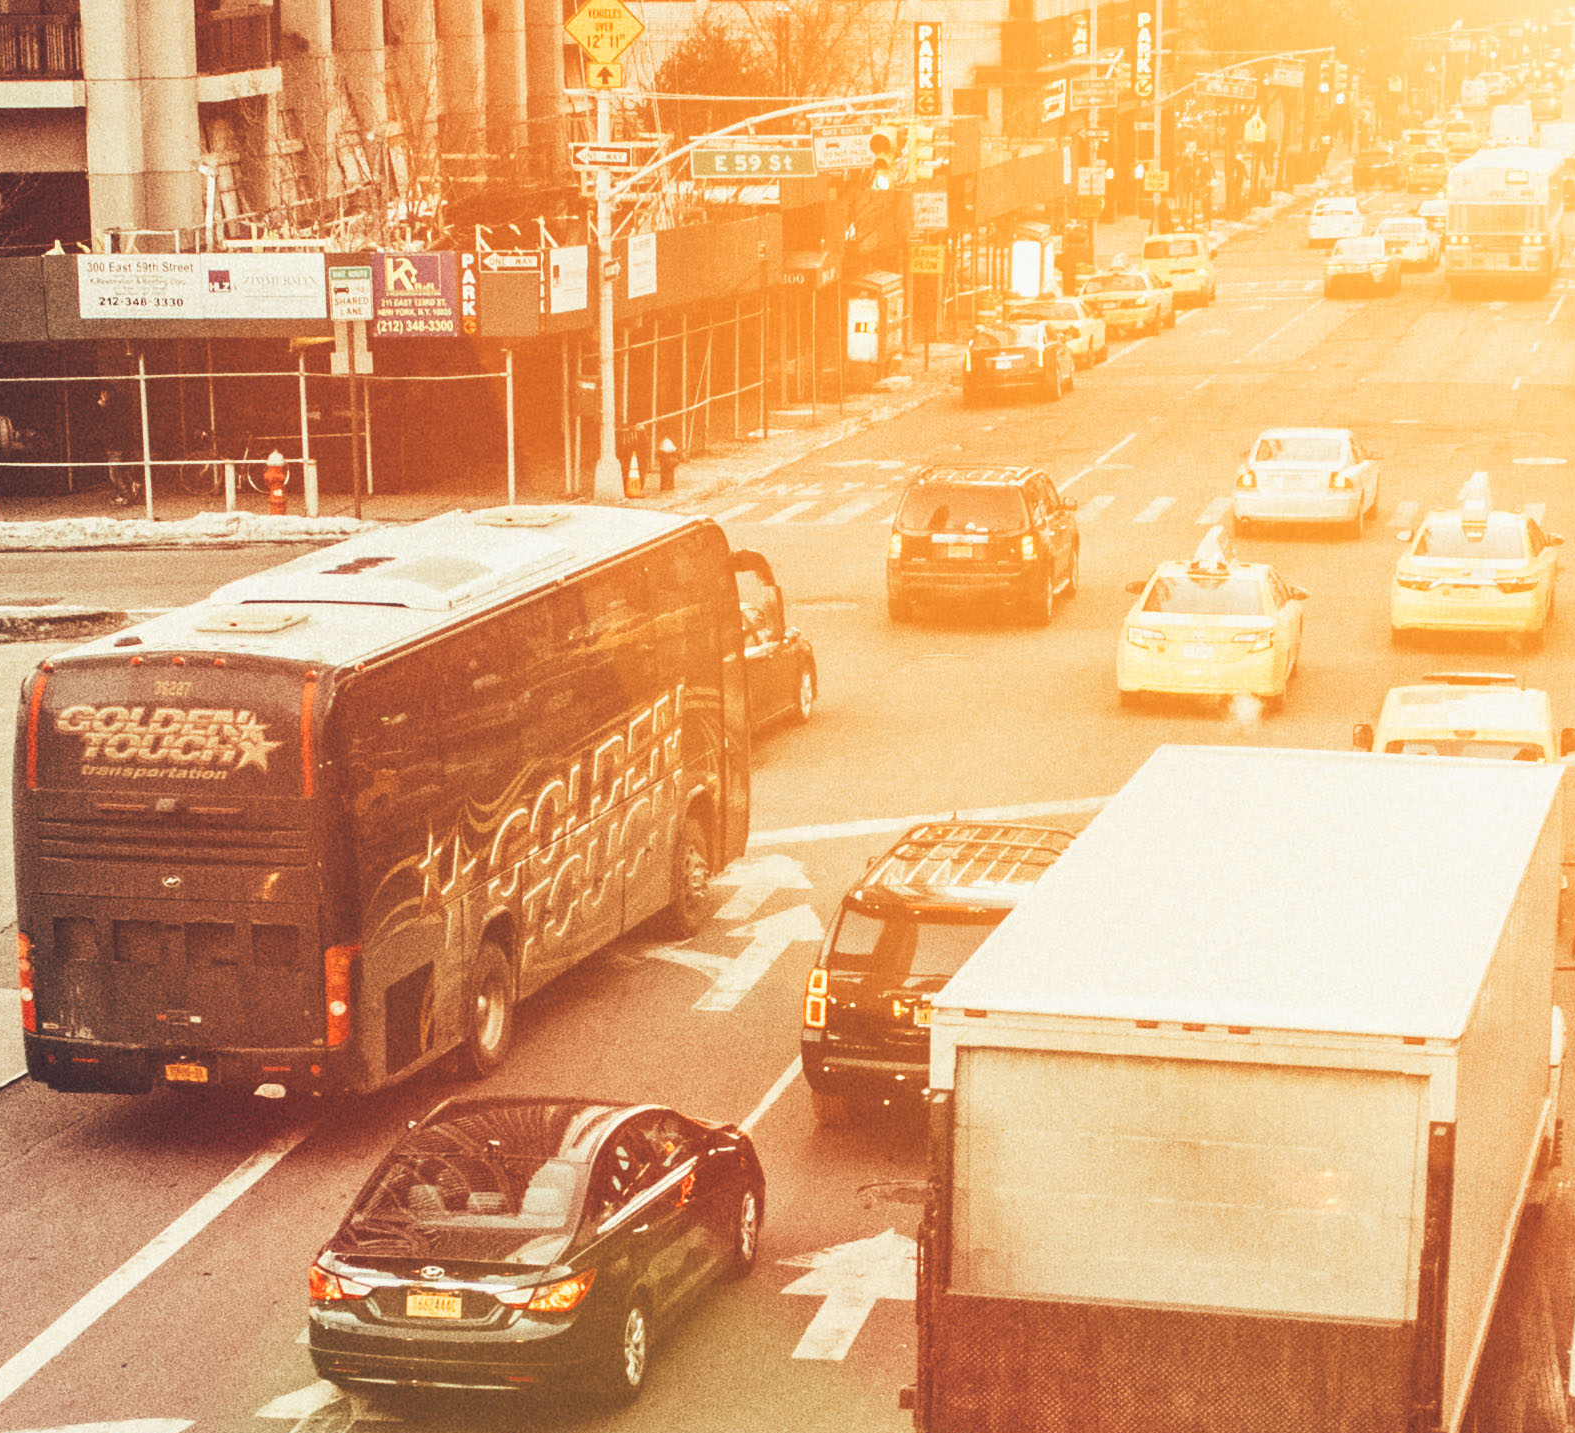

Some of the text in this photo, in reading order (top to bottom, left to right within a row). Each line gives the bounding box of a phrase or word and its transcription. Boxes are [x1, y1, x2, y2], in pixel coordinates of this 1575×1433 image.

[588, 9, 622, 19] VEHICLES
[595, 22, 614, 31] OVER
[1137, 12, 1151, 73] PARK
[919, 25, 932, 88] PARK
[606, 152, 624, 162] WAY
[715, 154, 793, 171] E 59 St
[87, 262, 194, 273] 300 East 59th Street
[461, 253, 476, 317] PARK
[334, 297, 369, 306] SHARED
[340, 308, 362, 316] LANE
[377, 320, 454, 333] (212) 348-3300
[56, 705, 257, 741] GOLDEN
[82, 732, 237, 764] TOUCH
[81, 764, 228, 780] transportation
[488, 683, 683, 899] GOLDEN
[520, 768, 683, 968] TOUCH
